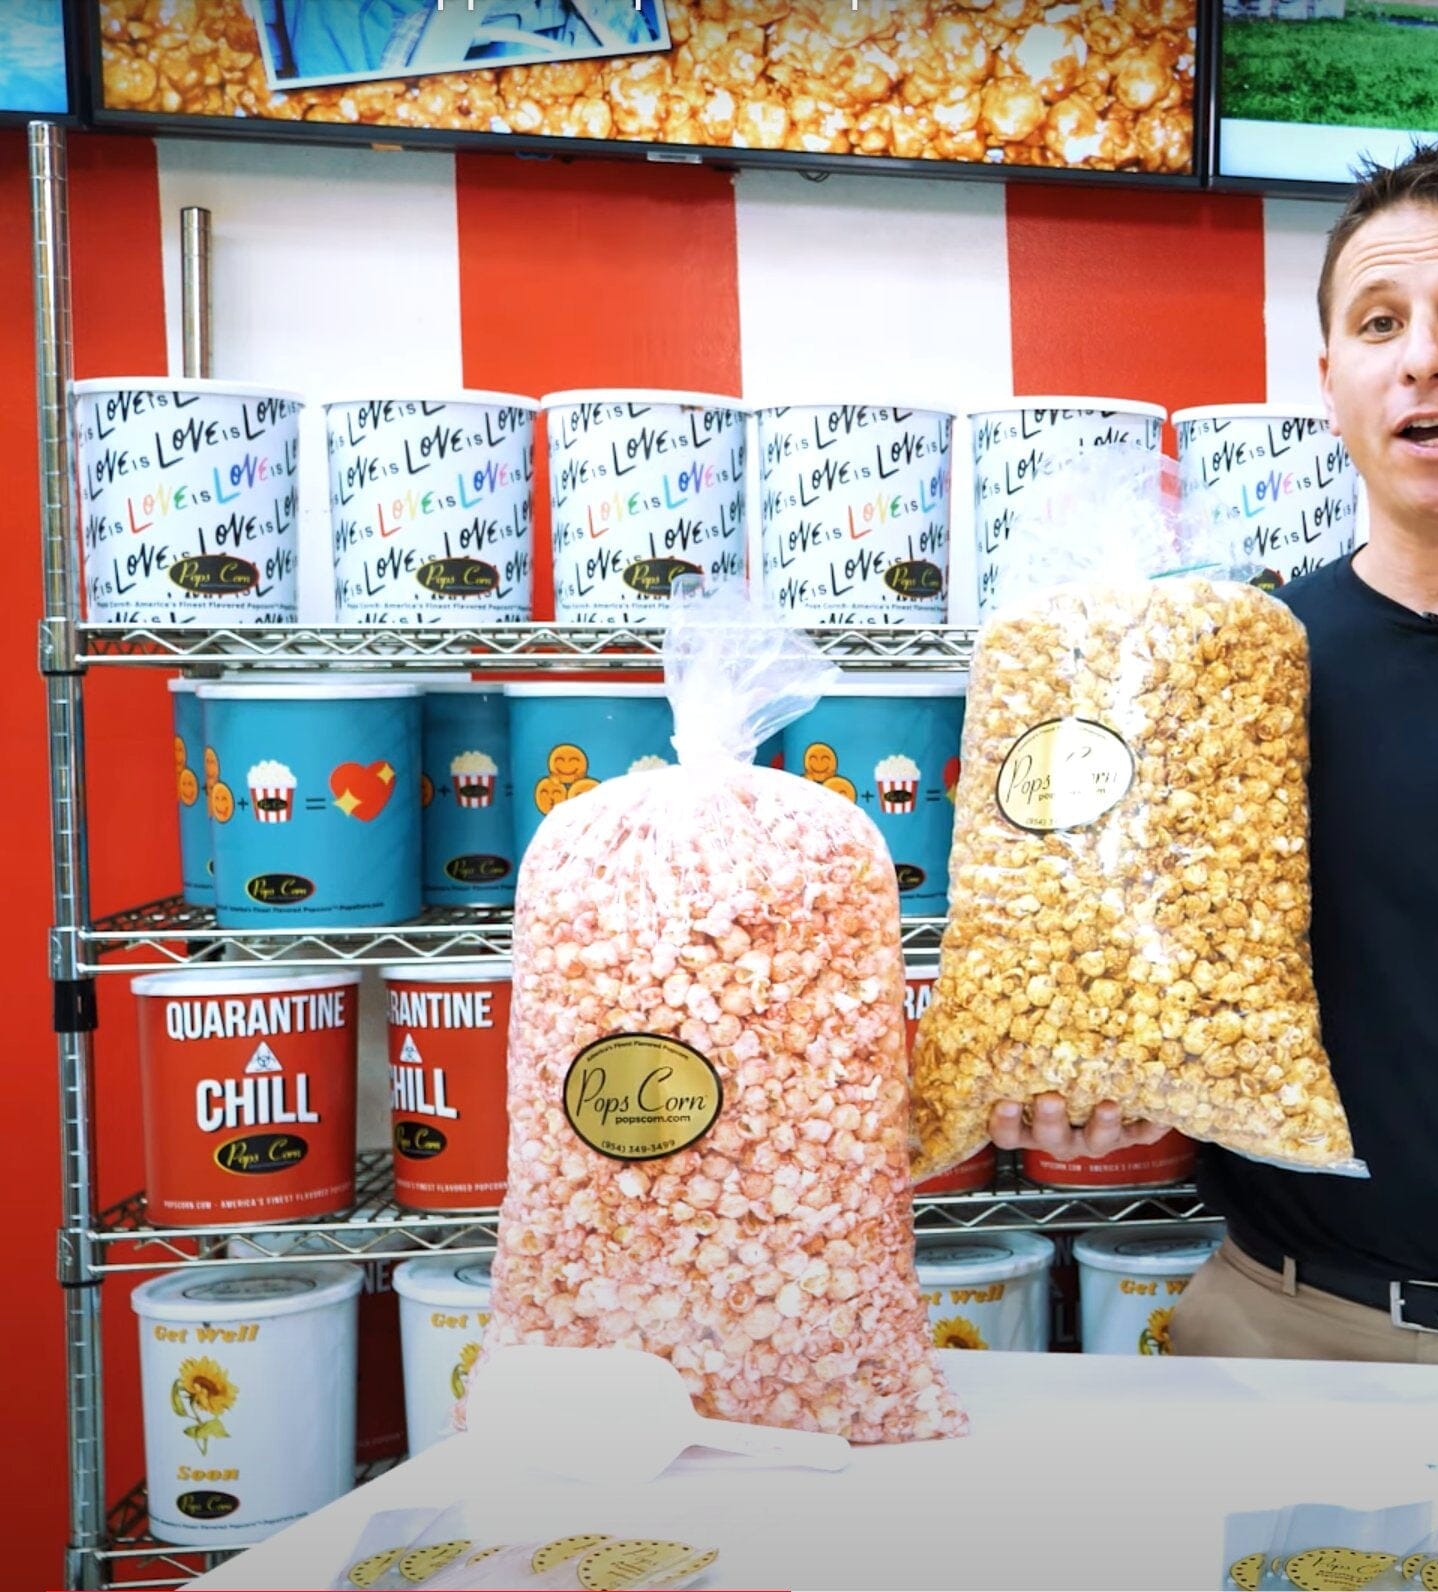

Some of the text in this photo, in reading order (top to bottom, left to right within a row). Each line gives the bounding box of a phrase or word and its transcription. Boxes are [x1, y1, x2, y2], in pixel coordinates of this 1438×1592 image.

[1006, 754, 1050, 805] Pops
[166, 991, 346, 1041] QUARANTINE
[389, 991, 494, 1029] RANTINE
[196, 1072, 319, 1133] CHILL
[391, 1067, 459, 1119] HILL
[576, 1067, 629, 1126] Pops
[615, 1114, 691, 1125] popscorn.com
[950, 1284, 1007, 1305] Well
[1119, 1278, 1157, 1297] Get
[154, 1323, 260, 1344] Get Well
[431, 1312, 468, 1329] Get
[176, 1465, 240, 1482] Soon
